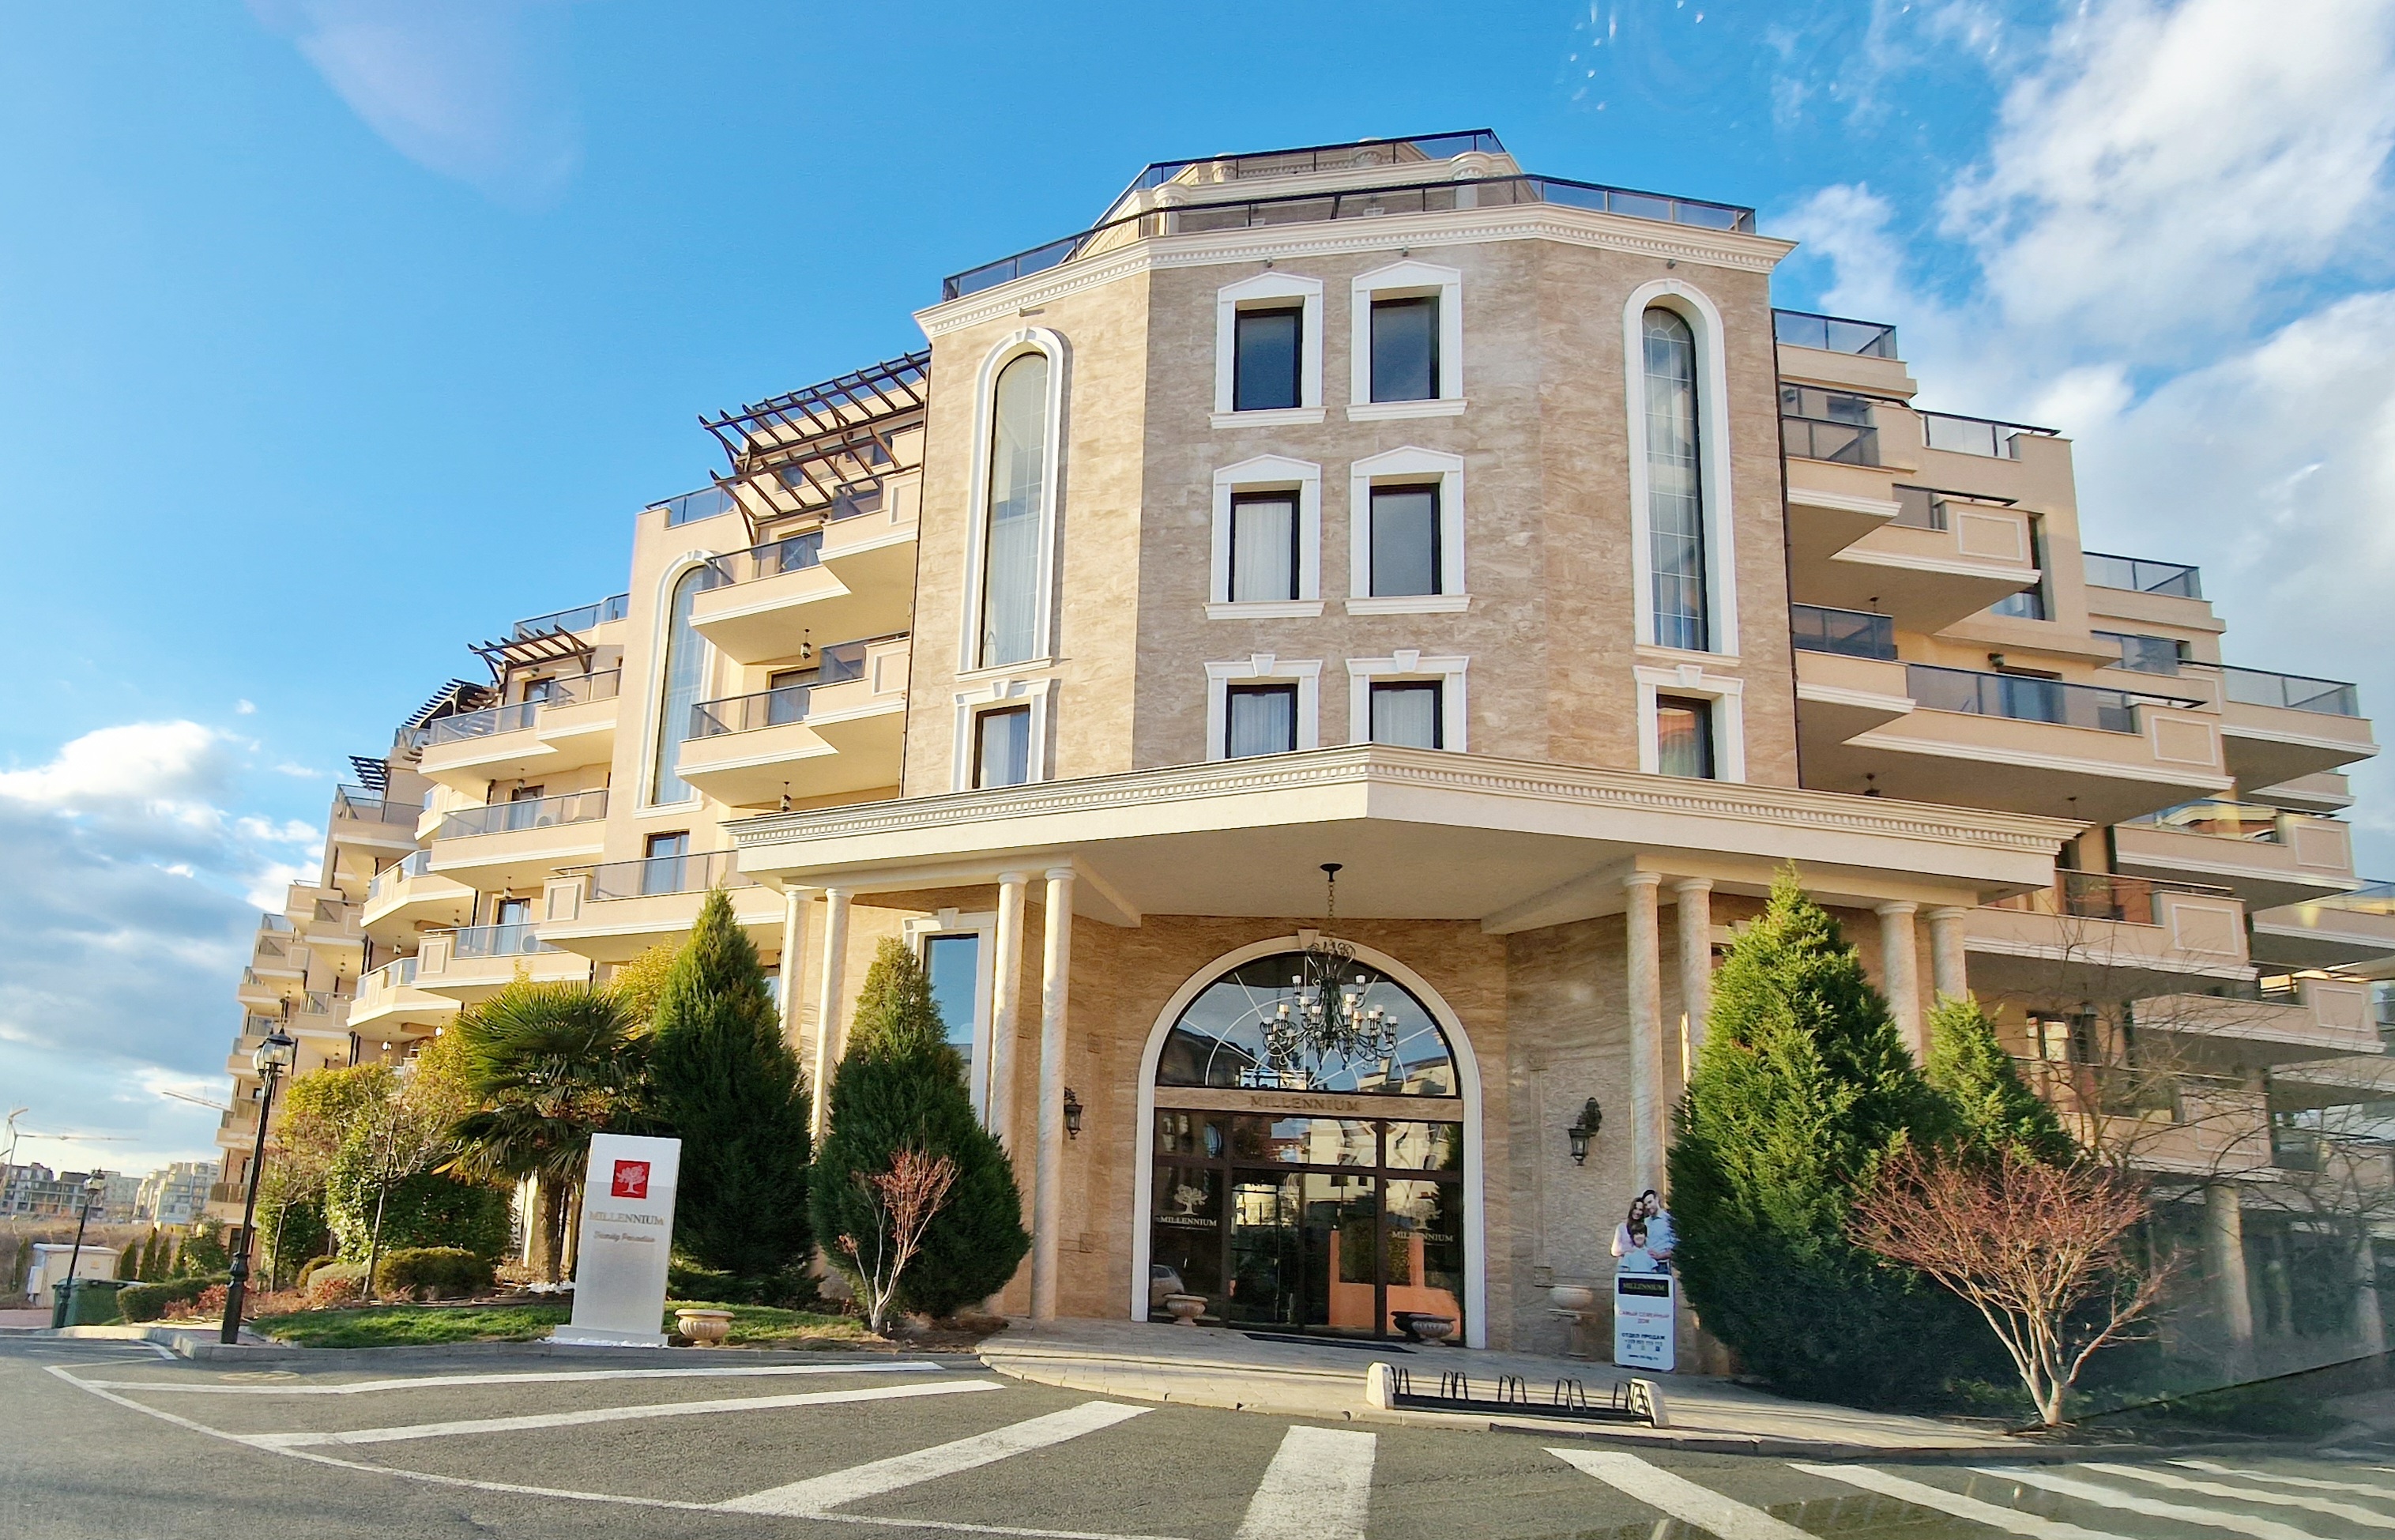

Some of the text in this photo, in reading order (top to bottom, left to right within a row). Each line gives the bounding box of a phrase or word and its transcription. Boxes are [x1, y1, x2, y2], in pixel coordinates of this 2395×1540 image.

[1250, 1095, 1360, 1112] MILLENNIUM
[589, 1211, 665, 1226] MILLENNIUM
[1161, 1216, 1218, 1227] MILLENNIUM
[1392, 1230, 1454, 1243] MILNNIUM
[1623, 1282, 1665, 1291] MILLENNIUM
